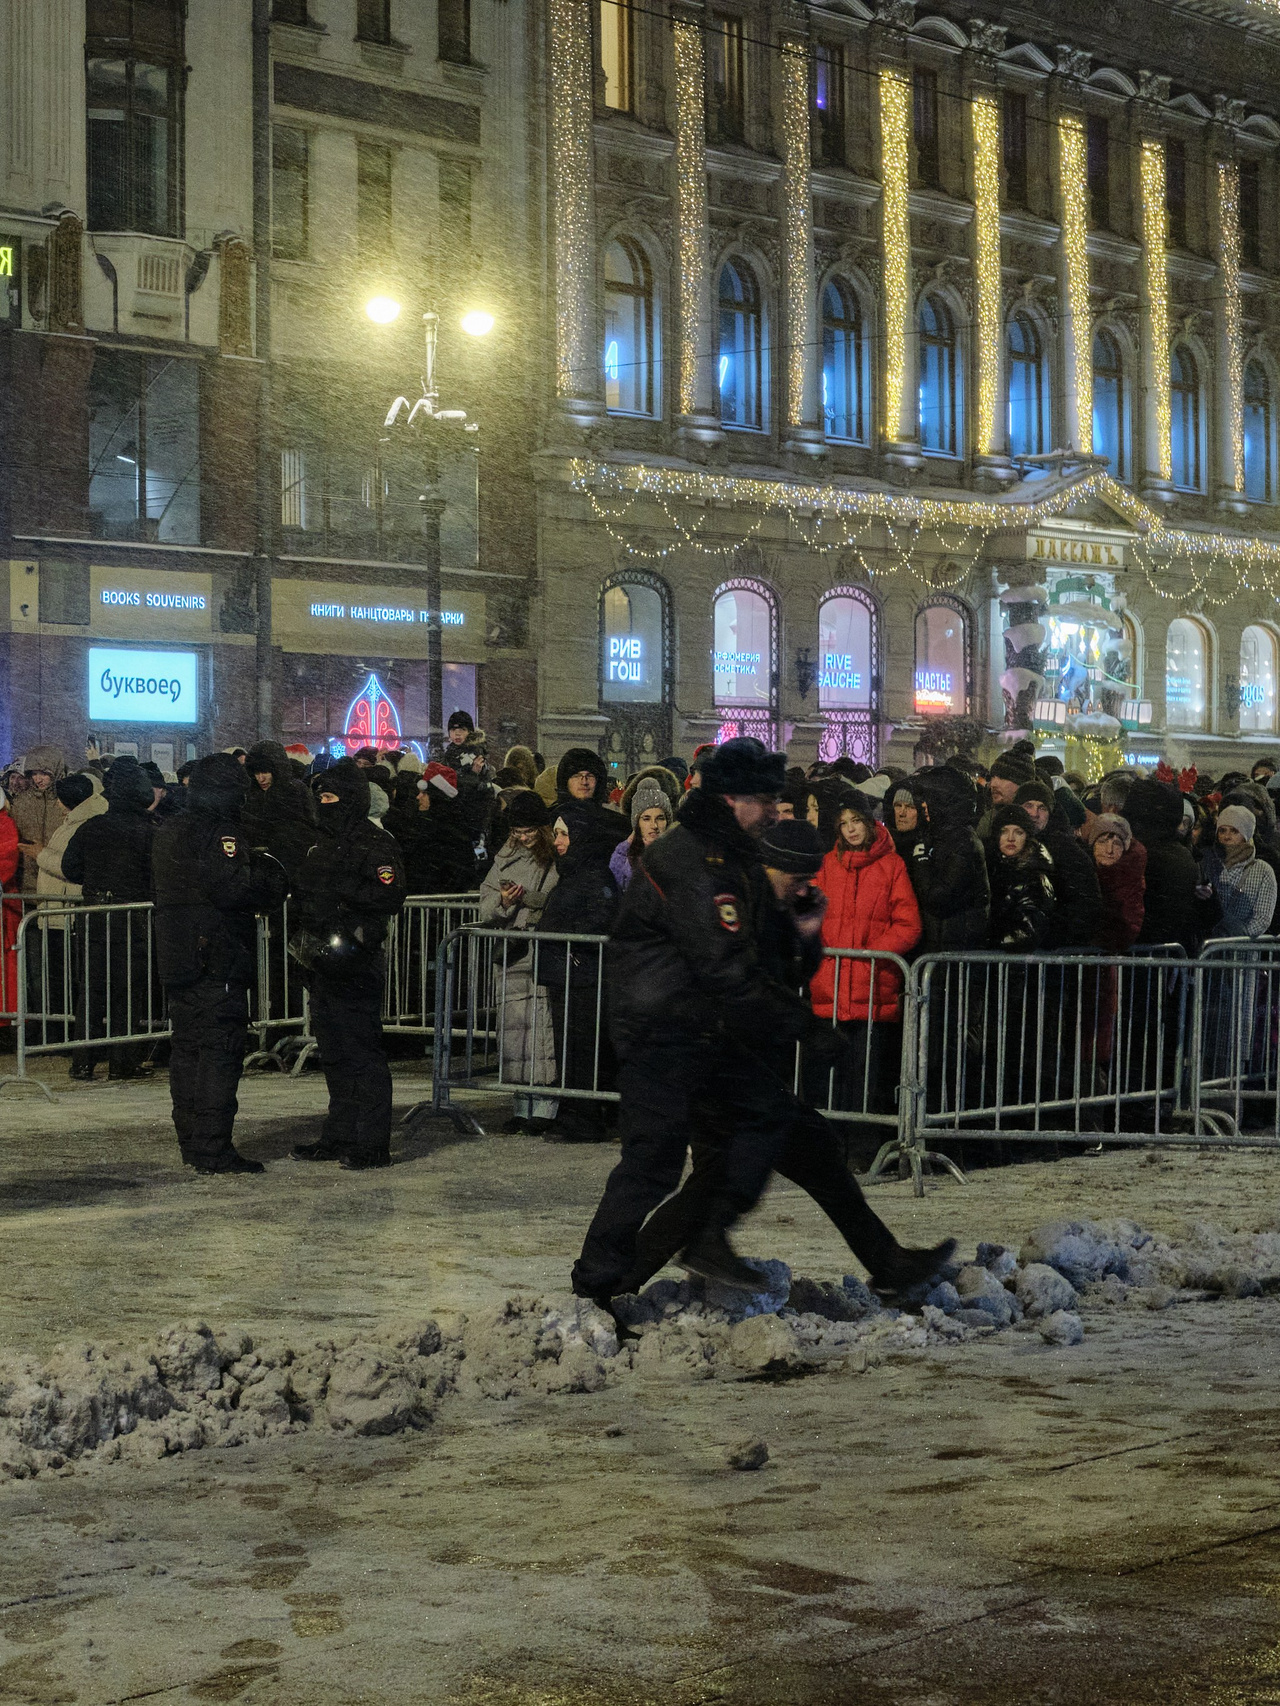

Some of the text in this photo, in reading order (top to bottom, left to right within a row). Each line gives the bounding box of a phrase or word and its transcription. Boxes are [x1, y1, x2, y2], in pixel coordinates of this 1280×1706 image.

[1033, 538, 1119, 565] ПАССАЖЪ
[102, 591, 206, 609] BOOKS SOUVENIRS
[311, 603, 464, 625] КНИГИ КАНЦТОВАРЫ ПАРКИ
[610, 638, 641, 658] РИВ
[714, 664, 756, 675] ОСМЕТИКА
[825, 653, 852, 670] RIVE
[100, 668, 181, 703] буквоед
[818, 671, 861, 689] GAUCHE
